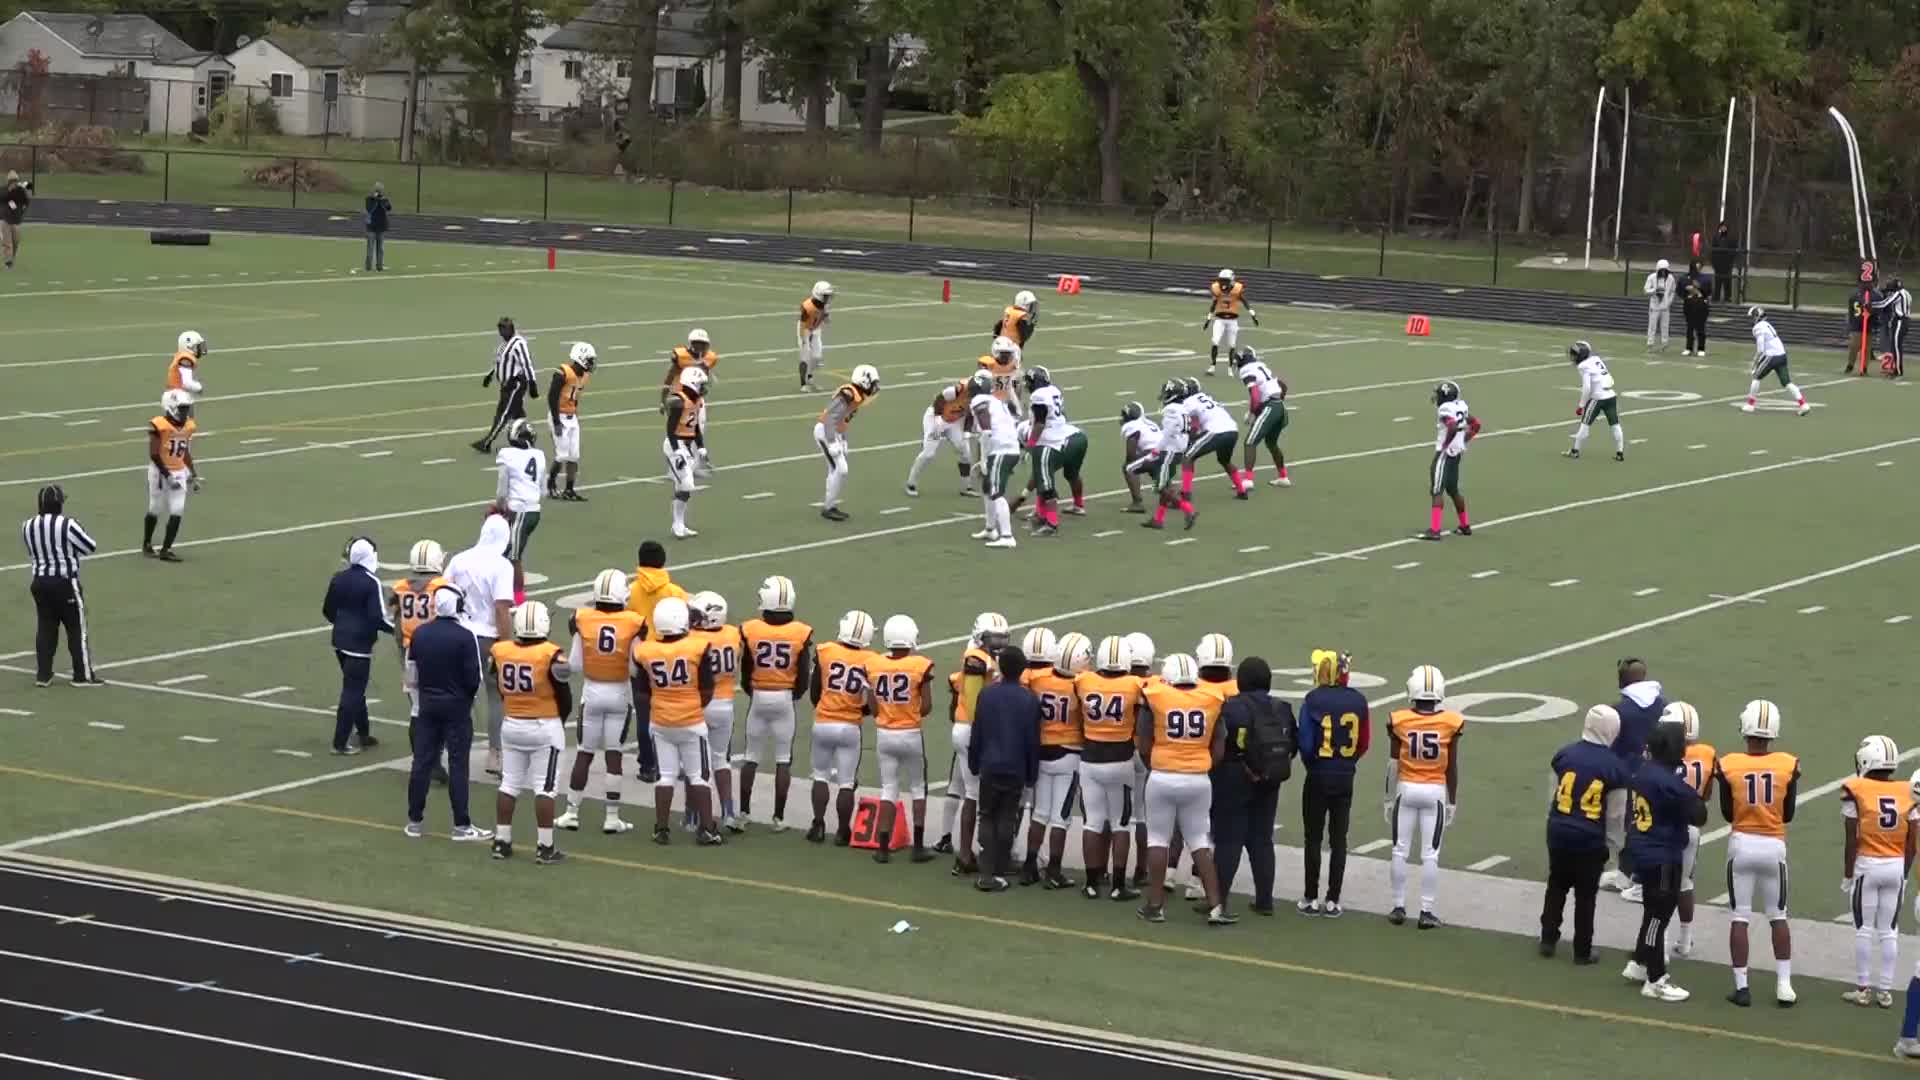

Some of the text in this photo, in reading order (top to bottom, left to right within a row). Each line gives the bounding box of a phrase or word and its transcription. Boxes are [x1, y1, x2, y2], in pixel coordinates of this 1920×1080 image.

[1859, 261, 1873, 282] 2
[1408, 317, 1423, 331] 10
[1051, 394, 1063, 417] 5
[523, 456, 538, 483] 4
[402, 592, 430, 620] 93
[596, 624, 615, 654] 6
[753, 640, 790, 670] 25
[500, 662, 533, 693] 95
[648, 658, 689, 689] 54
[827, 661, 865, 695] 26
[873, 672, 909, 702] 42
[1040, 691, 1070, 725] 51
[1084, 692, 1124, 723] 34
[1166, 709, 1204, 740] 99
[1316, 713, 1360, 758] 13
[1405, 730, 1440, 761] 15
[1556, 770, 1604, 815] 44
[1742, 773, 1772, 805] 11
[1632, 793, 1653, 832] 0
[1876, 796, 1898, 829] 5
